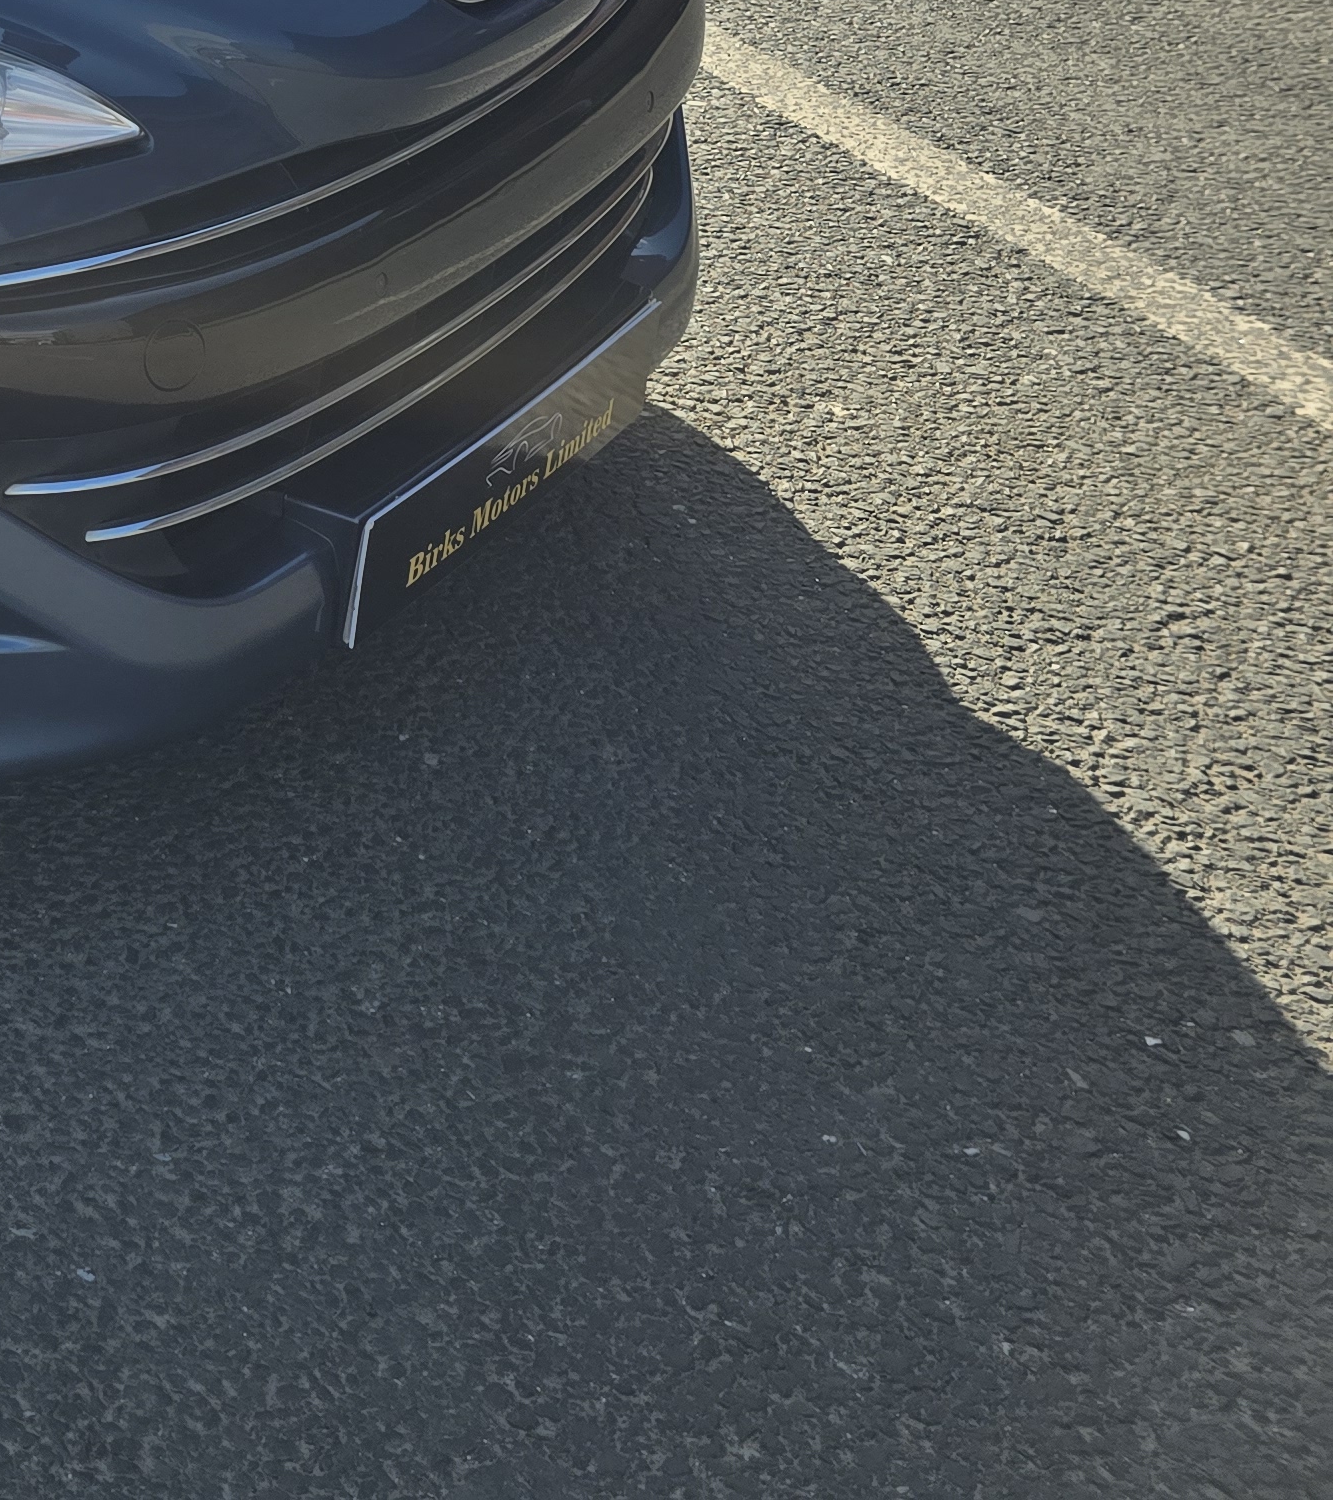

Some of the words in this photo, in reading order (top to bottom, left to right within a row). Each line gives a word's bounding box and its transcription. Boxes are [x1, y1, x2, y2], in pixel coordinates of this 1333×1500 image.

[406, 526, 465, 588] Birks
[470, 468, 539, 538] Motors
[543, 397, 614, 480] Limited
